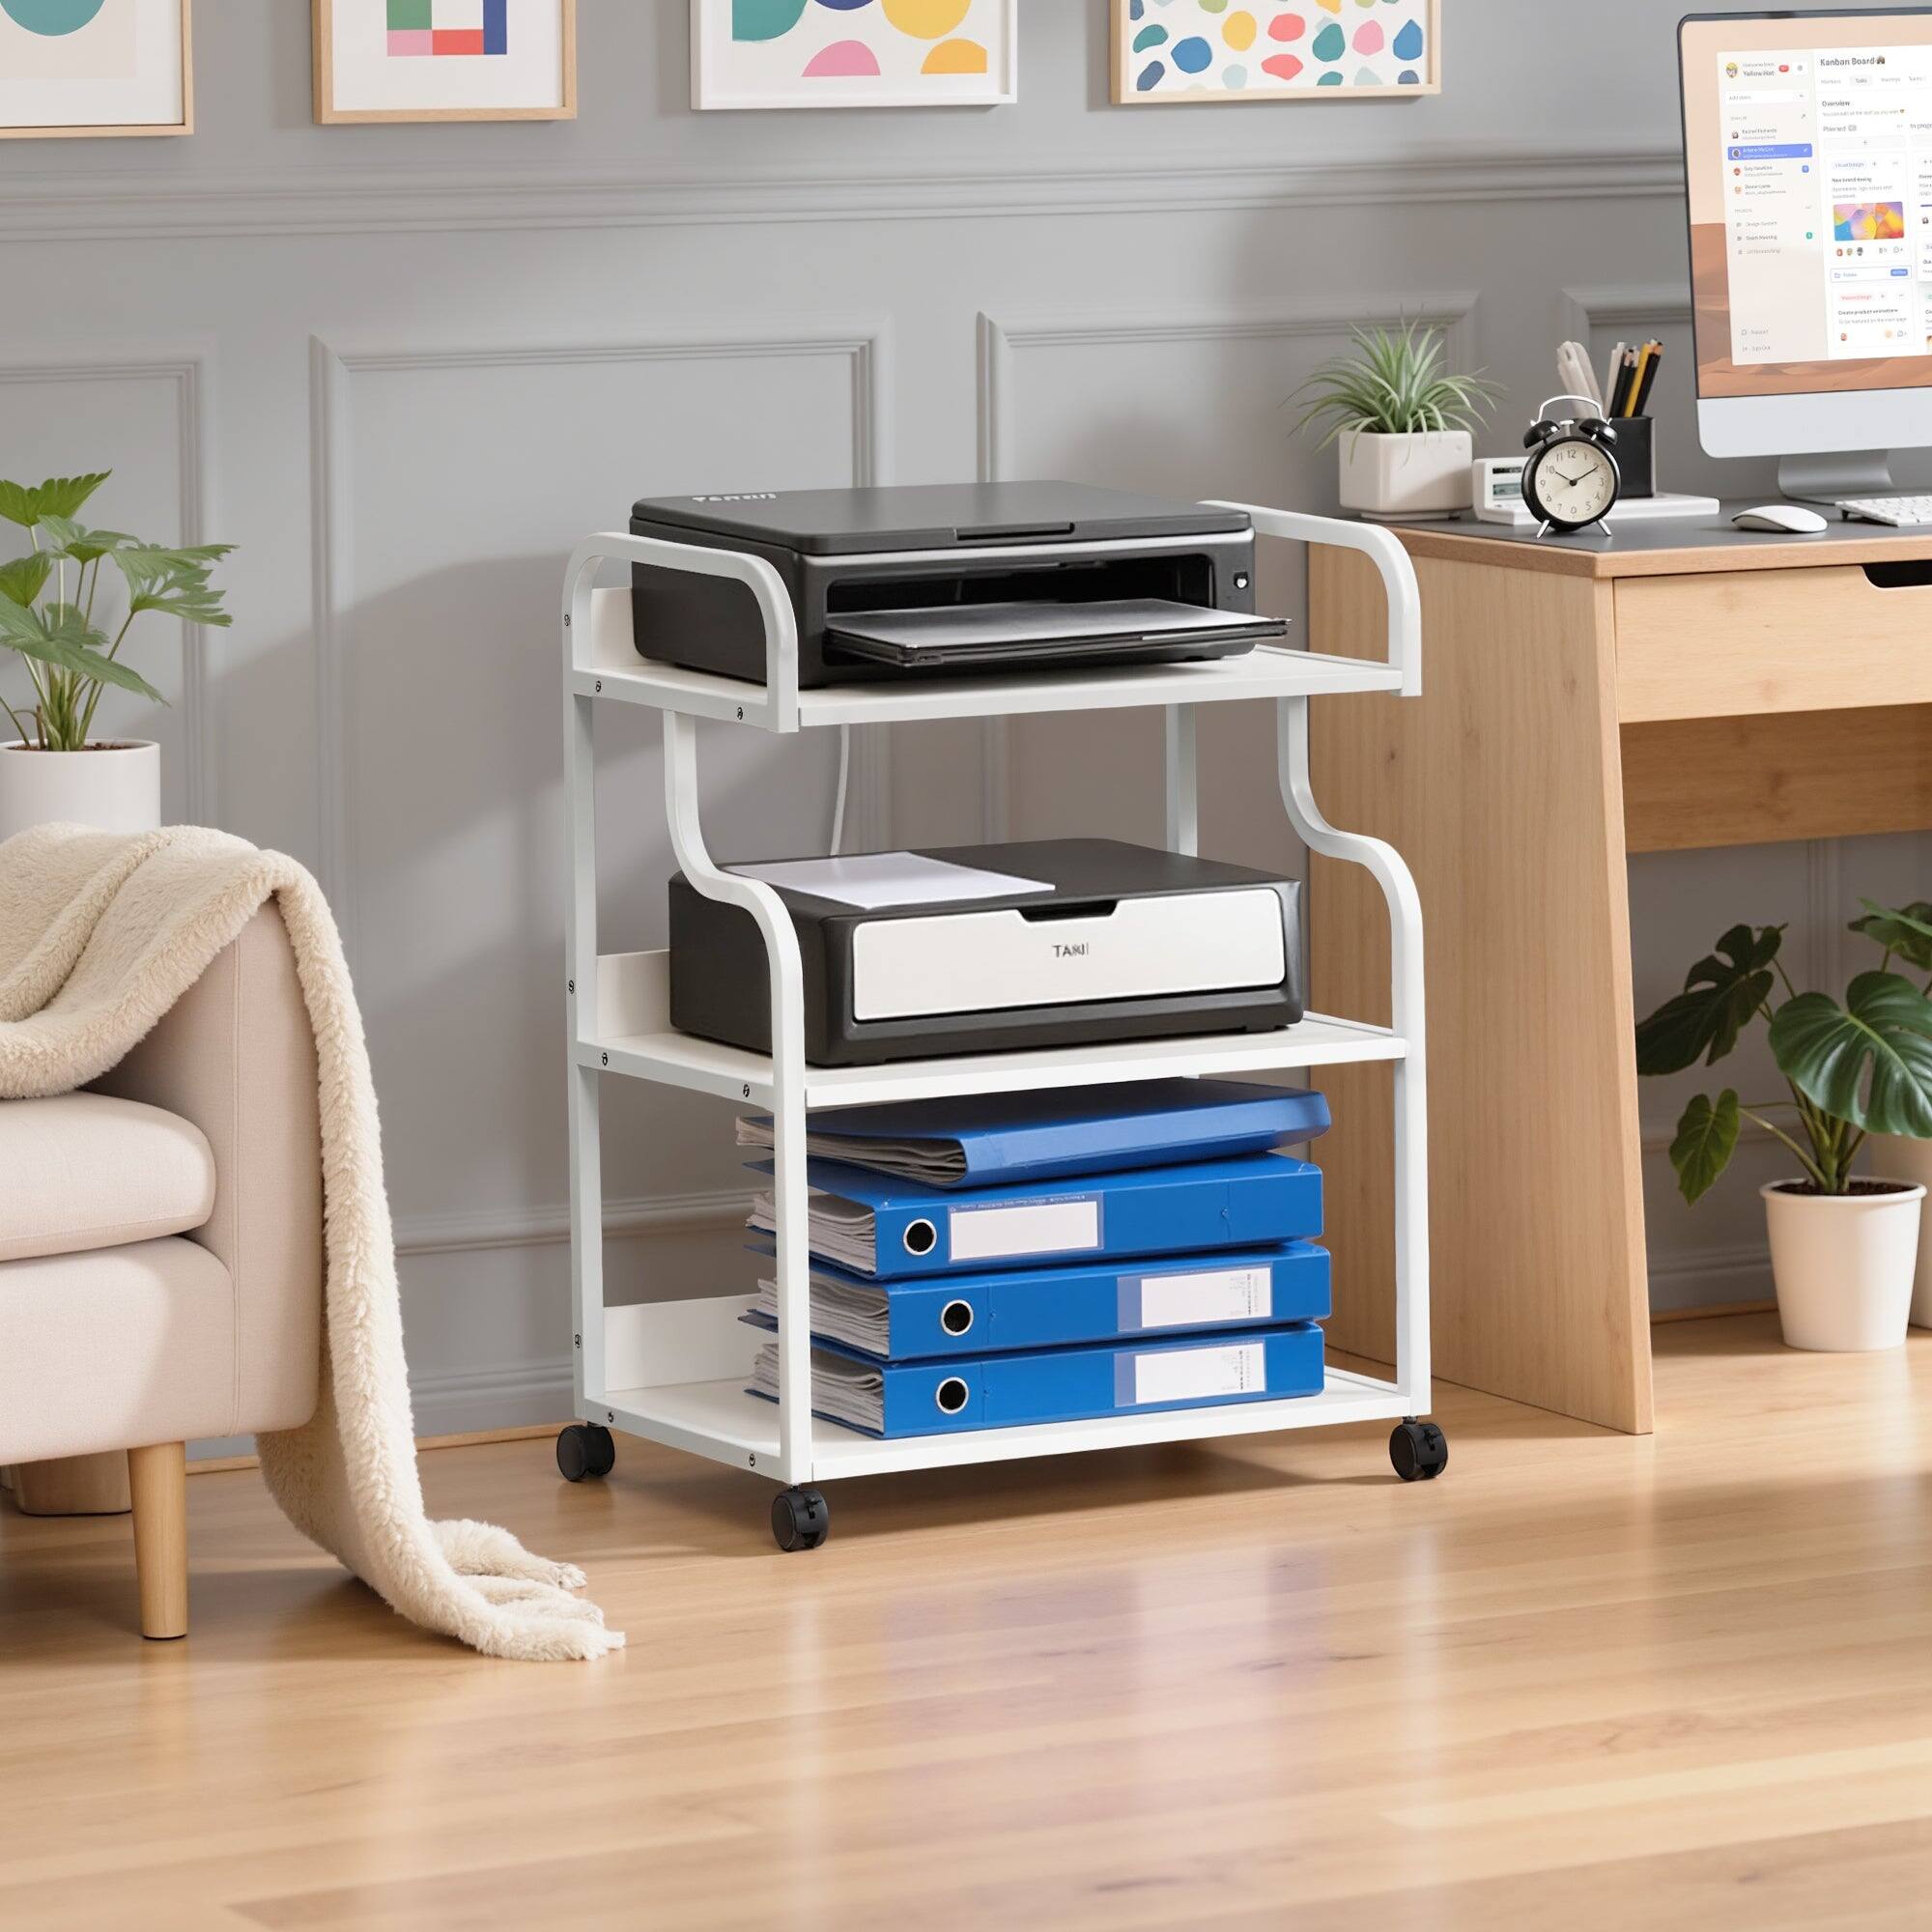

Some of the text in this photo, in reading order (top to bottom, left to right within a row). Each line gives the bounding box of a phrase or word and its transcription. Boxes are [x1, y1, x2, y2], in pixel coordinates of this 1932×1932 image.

[1820, 58, 1850, 67] Kanban
[1556, 453, 1563, 463] 11
[1567, 449, 1577, 459] 12
[1546, 465, 1555, 474] 10
